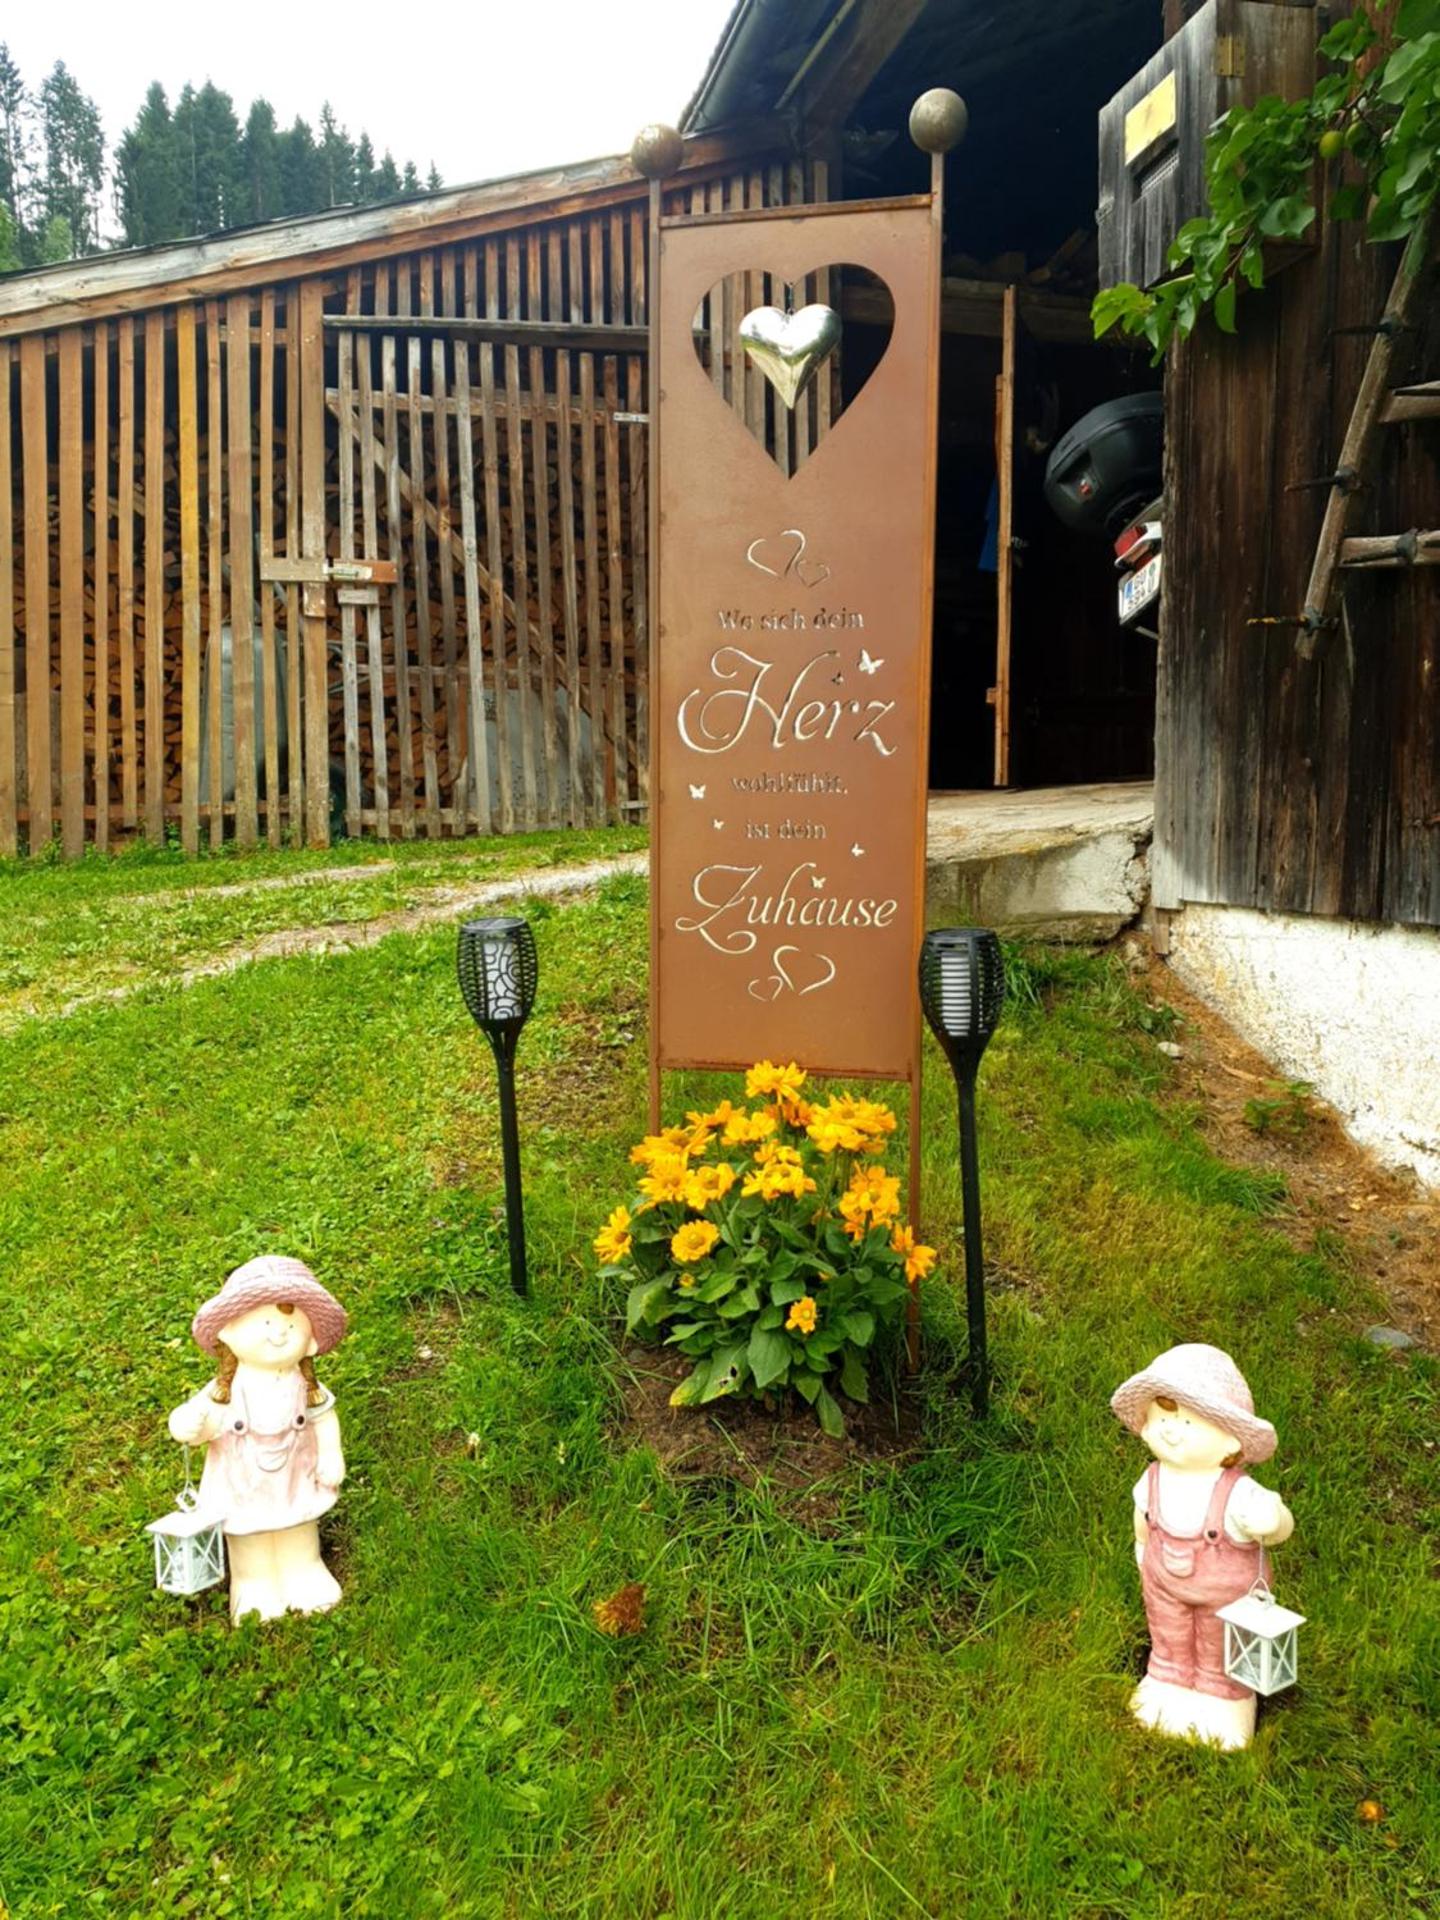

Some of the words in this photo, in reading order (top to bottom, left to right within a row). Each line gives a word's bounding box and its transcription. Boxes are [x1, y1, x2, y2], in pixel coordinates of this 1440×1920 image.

[717, 609, 754, 630] Wo
[761, 607, 806, 630] sich
[813, 606, 864, 630] dein
[678, 646, 898, 756] Herz
[746, 818, 770, 839] ist
[778, 818, 827, 839] dein
[675, 862, 898, 955] Zuhause
